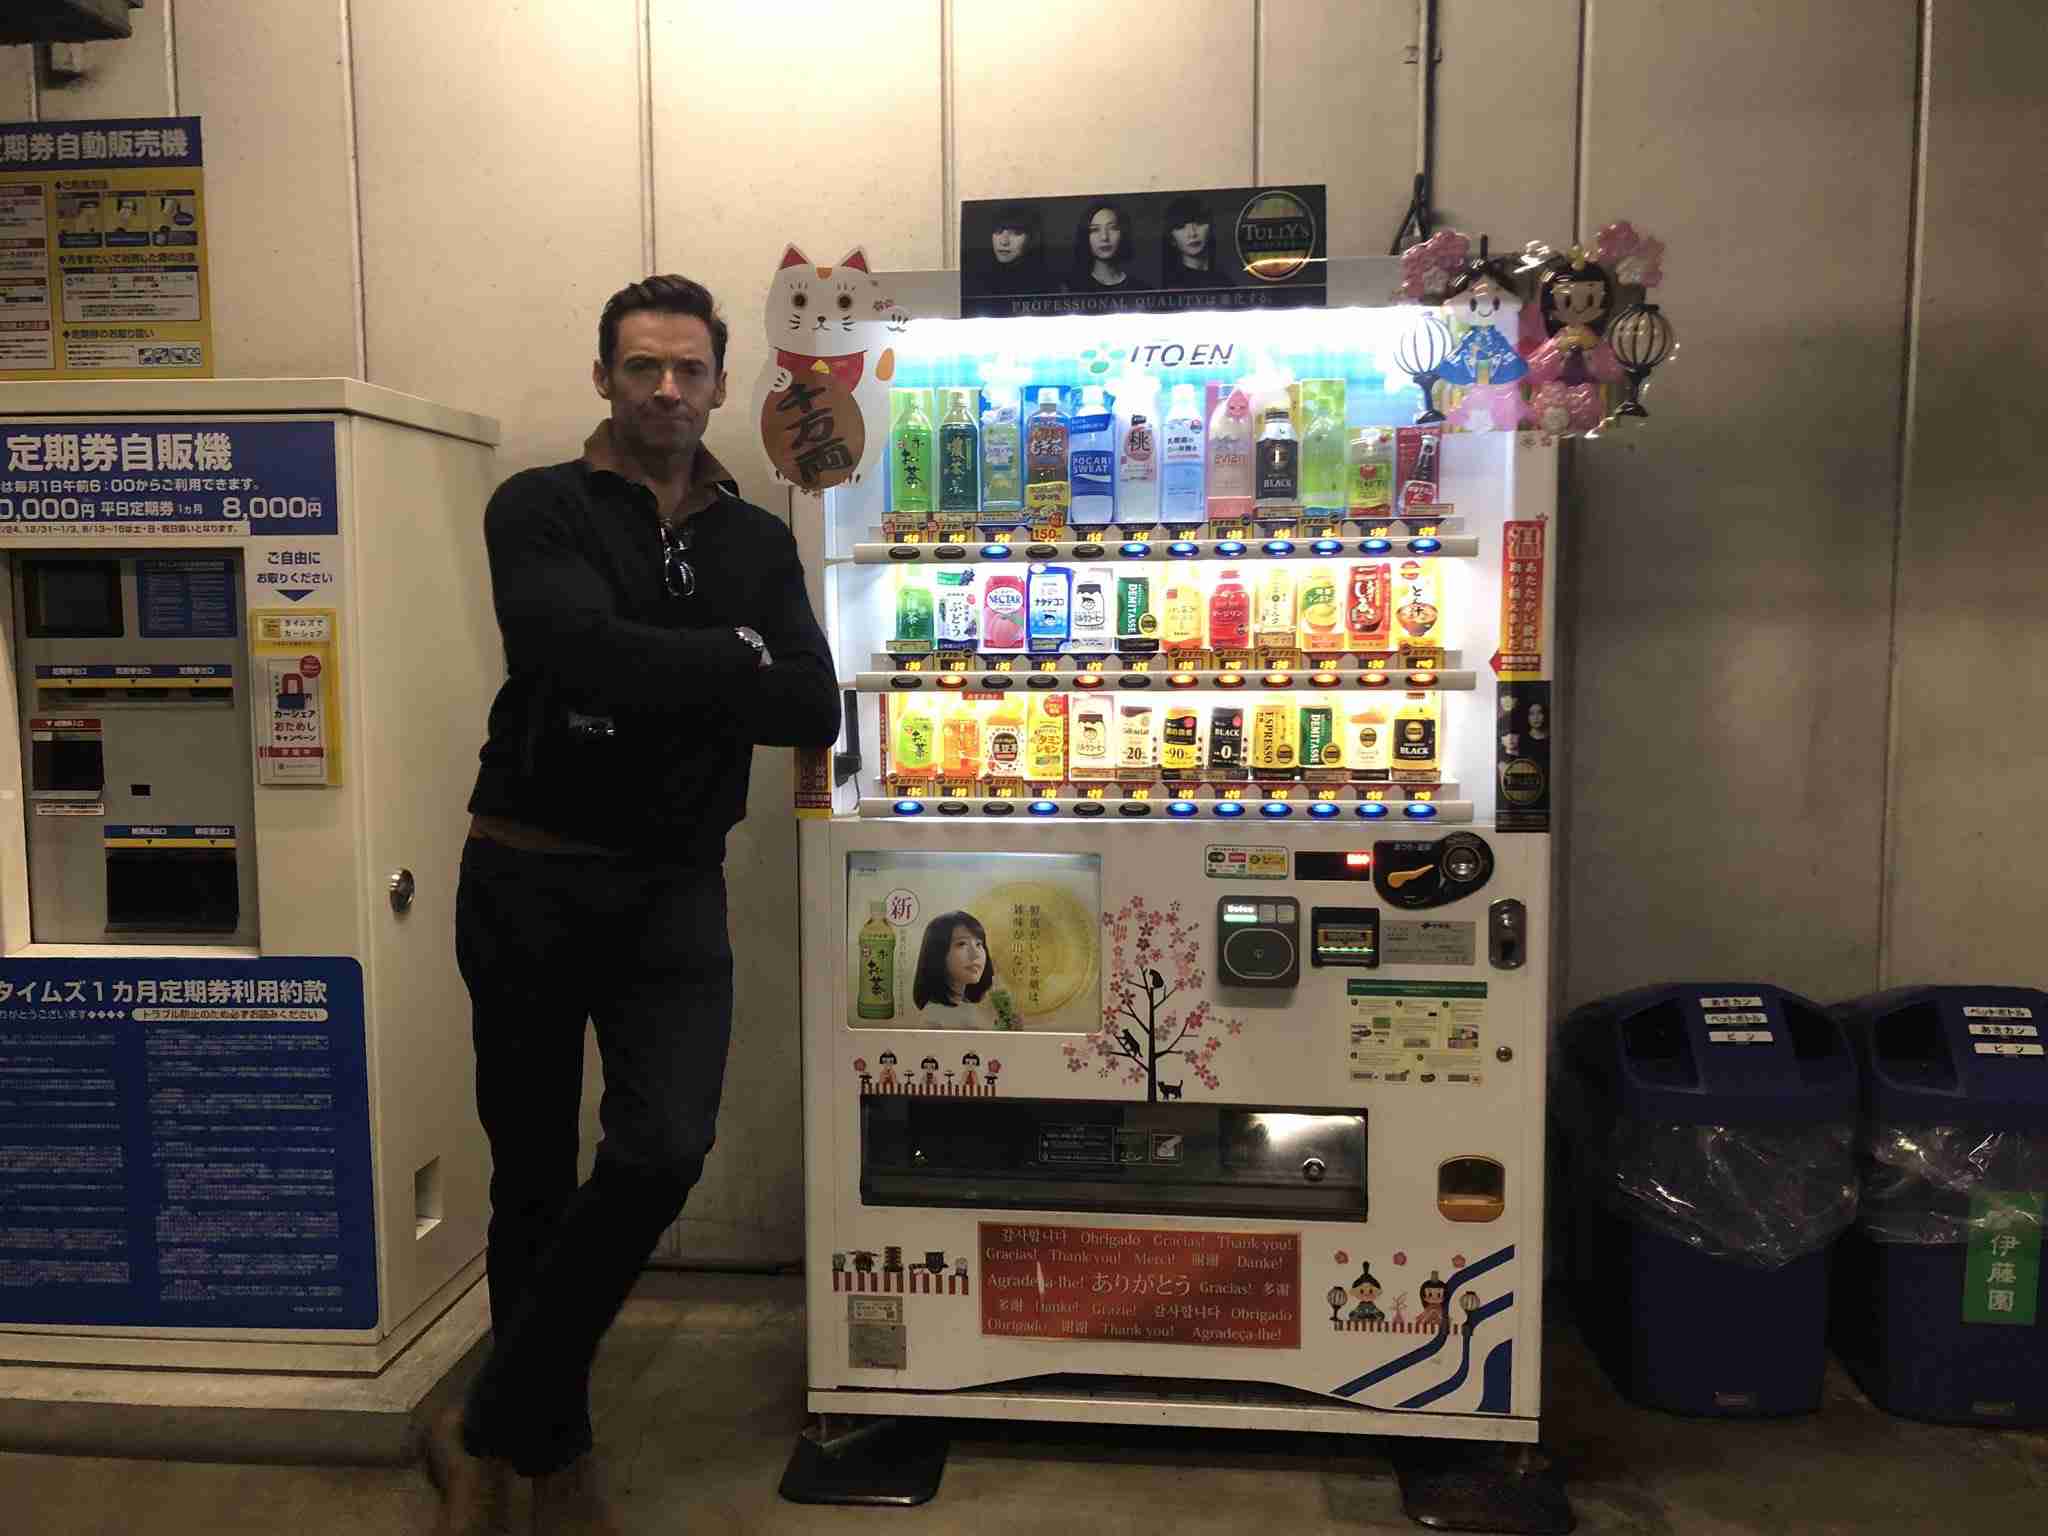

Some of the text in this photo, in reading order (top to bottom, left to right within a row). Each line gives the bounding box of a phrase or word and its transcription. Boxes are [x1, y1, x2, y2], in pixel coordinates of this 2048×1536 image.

[0, 128, 188, 161] 期券自動販売機
[1130, 343, 1234, 367] ITO EN
[1129, 429, 1151, 452] 桃
[6, 432, 233, 472] 定期券自販機
[1072, 456, 1112, 466] POCARI
[1072, 465, 1109, 474] SWEAT
[101, 501, 175, 517] 平日定期券
[222, 496, 321, 520] 8,000円
[267, 551, 321, 565] ご自由に
[257, 572, 334, 584] お取りください
[1127, 583, 1138, 634] DEMITASSE
[274, 721, 315, 732] おためし
[1214, 728, 1241, 737] BLACK
[1263, 711, 1274, 764] ESPRESSO
[1309, 714, 1320, 764] DEMITASSE
[1127, 747, 1142, 760] 20
[1168, 748, 1185, 760] 90
[1400, 746, 1430, 755] BLACK
[890, 896, 912, 920] 新
[1080, 1231, 1142, 1248] Obrigado
[1216, 1235, 1294, 1253] Thank you!
[1050, 1249, 1089, 1263] Thank
[1238, 1255, 1283, 1270] Danke!
[1986, 1234, 2020, 1312] 伊藤園
[1091, 1271, 1191, 1296] ありがとう
[1232, 1307, 1293, 1326] Obrigado
[1104, 1323, 1144, 1337] Thank
